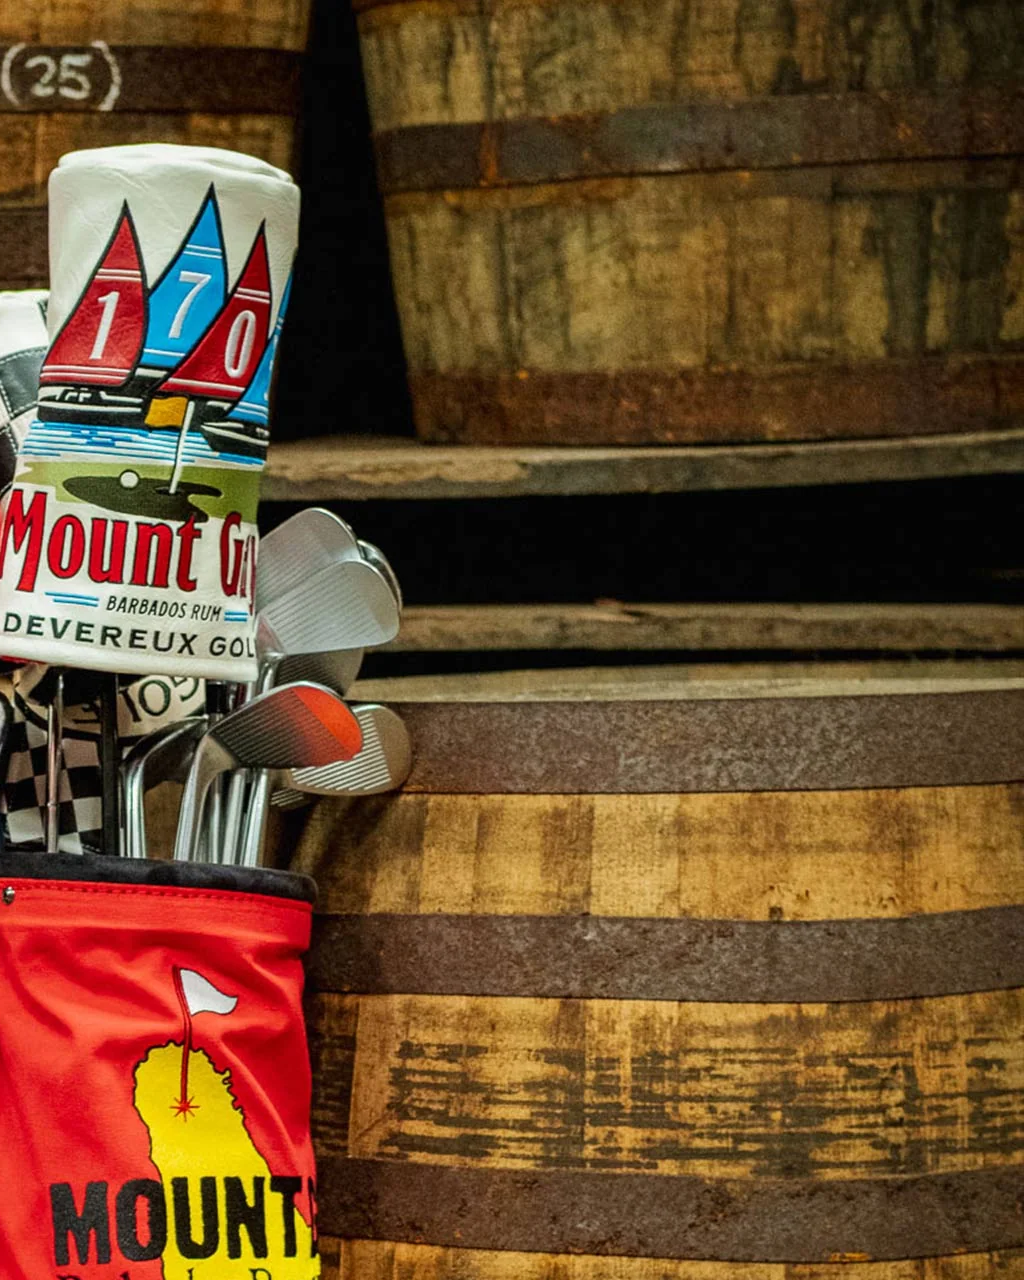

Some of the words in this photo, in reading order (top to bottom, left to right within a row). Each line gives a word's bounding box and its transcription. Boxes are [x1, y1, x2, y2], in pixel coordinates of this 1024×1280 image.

[105, 595, 188, 620] BARBADOS
[190, 604, 222, 622] RUM
[3, 611, 199, 657] DEVEREUX
[49, 1175, 303, 1267] MOUNT
